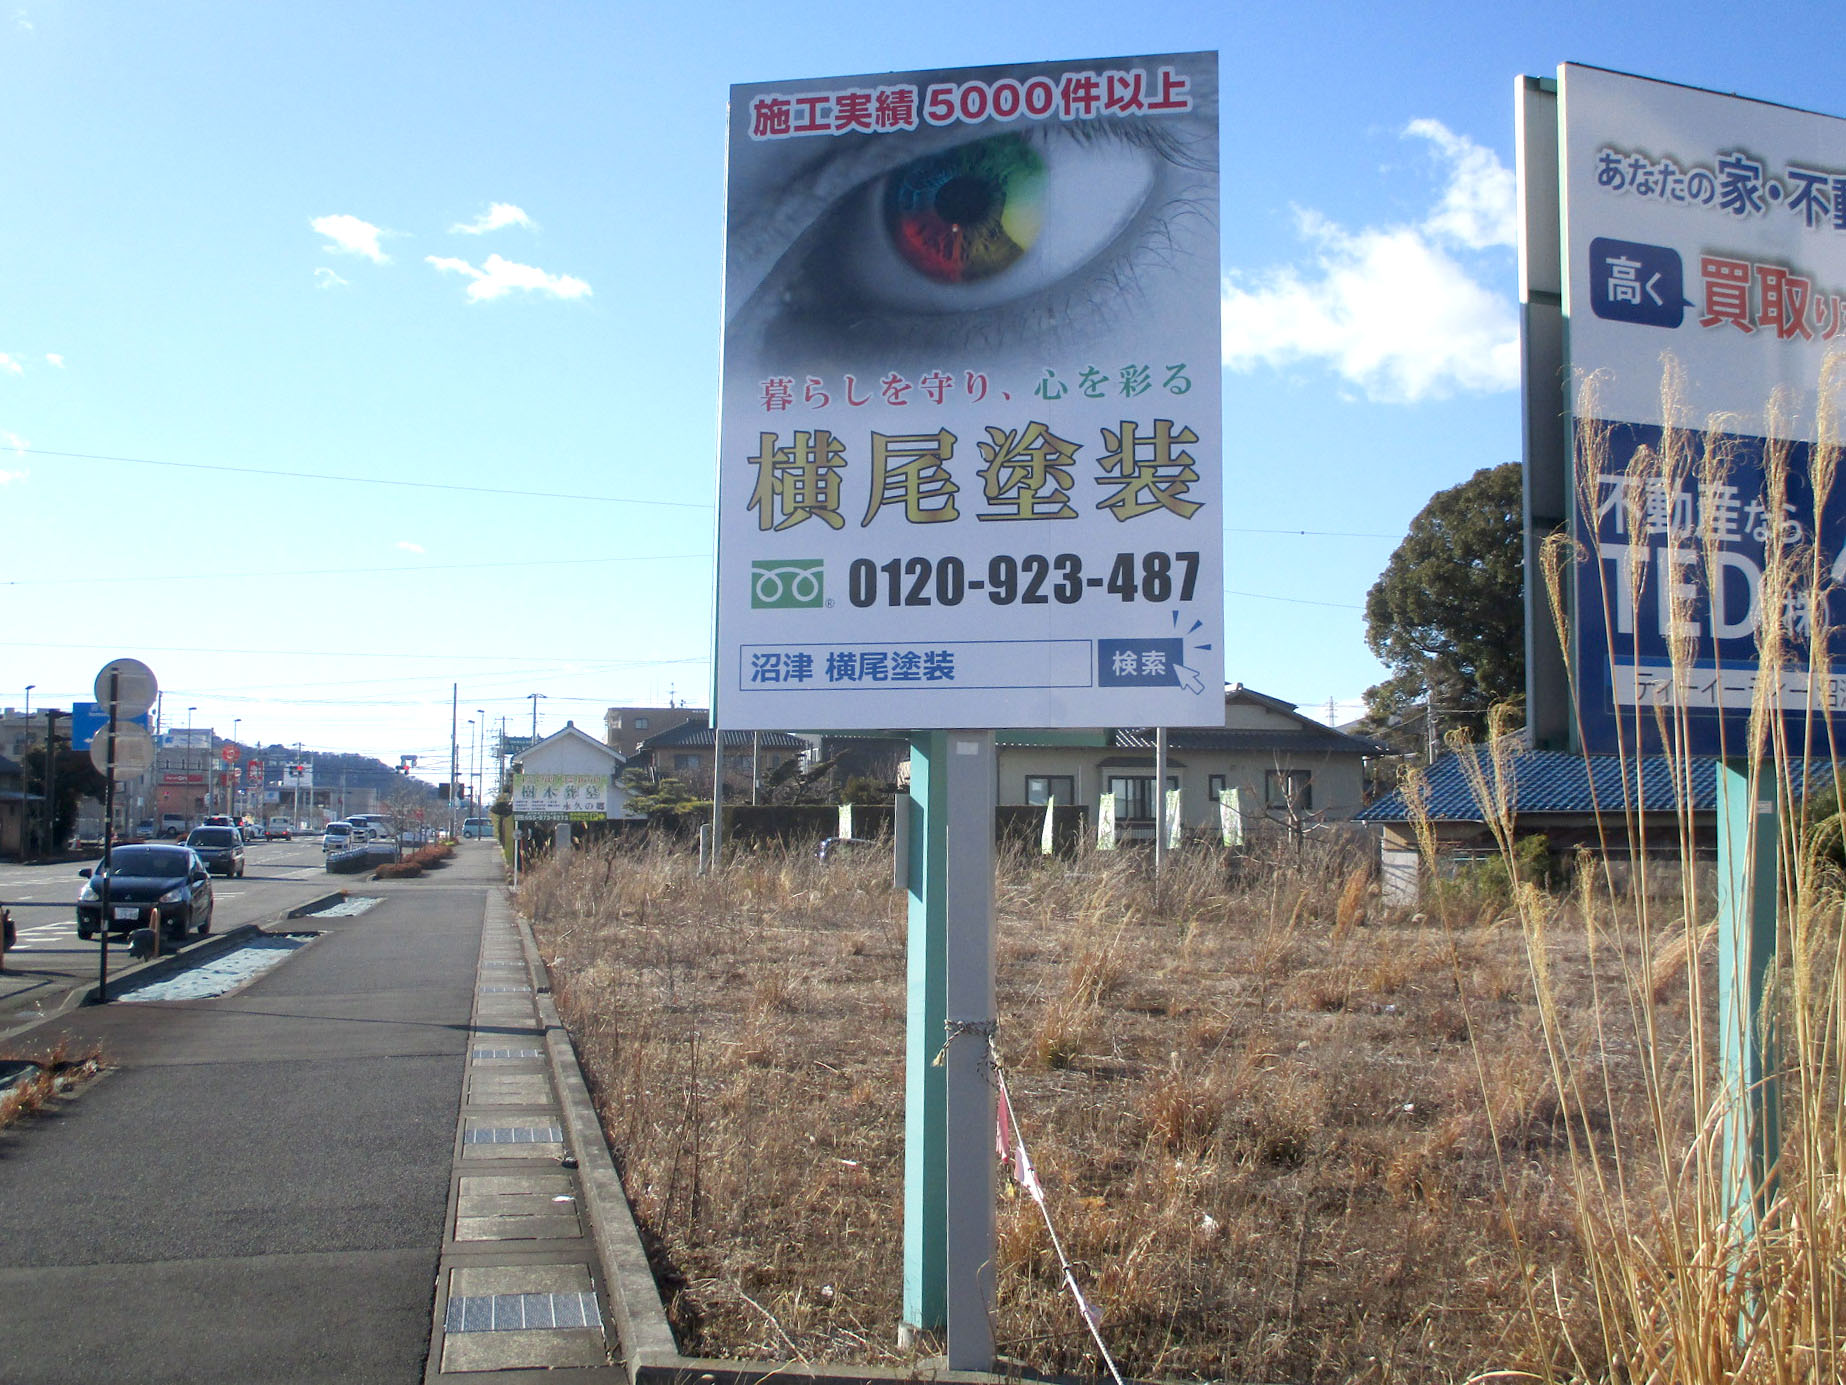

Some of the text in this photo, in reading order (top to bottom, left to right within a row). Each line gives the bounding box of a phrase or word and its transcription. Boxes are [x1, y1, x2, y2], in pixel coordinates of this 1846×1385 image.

[1605, 255, 1846, 340] 高く 買取り
[747, 419, 1206, 531] 横尾塗装
[848, 551, 1201, 608] 0120-923-487
[751, 650, 956, 683] 沼津 横尾塗装
[1112, 650, 1167, 678] 検索
